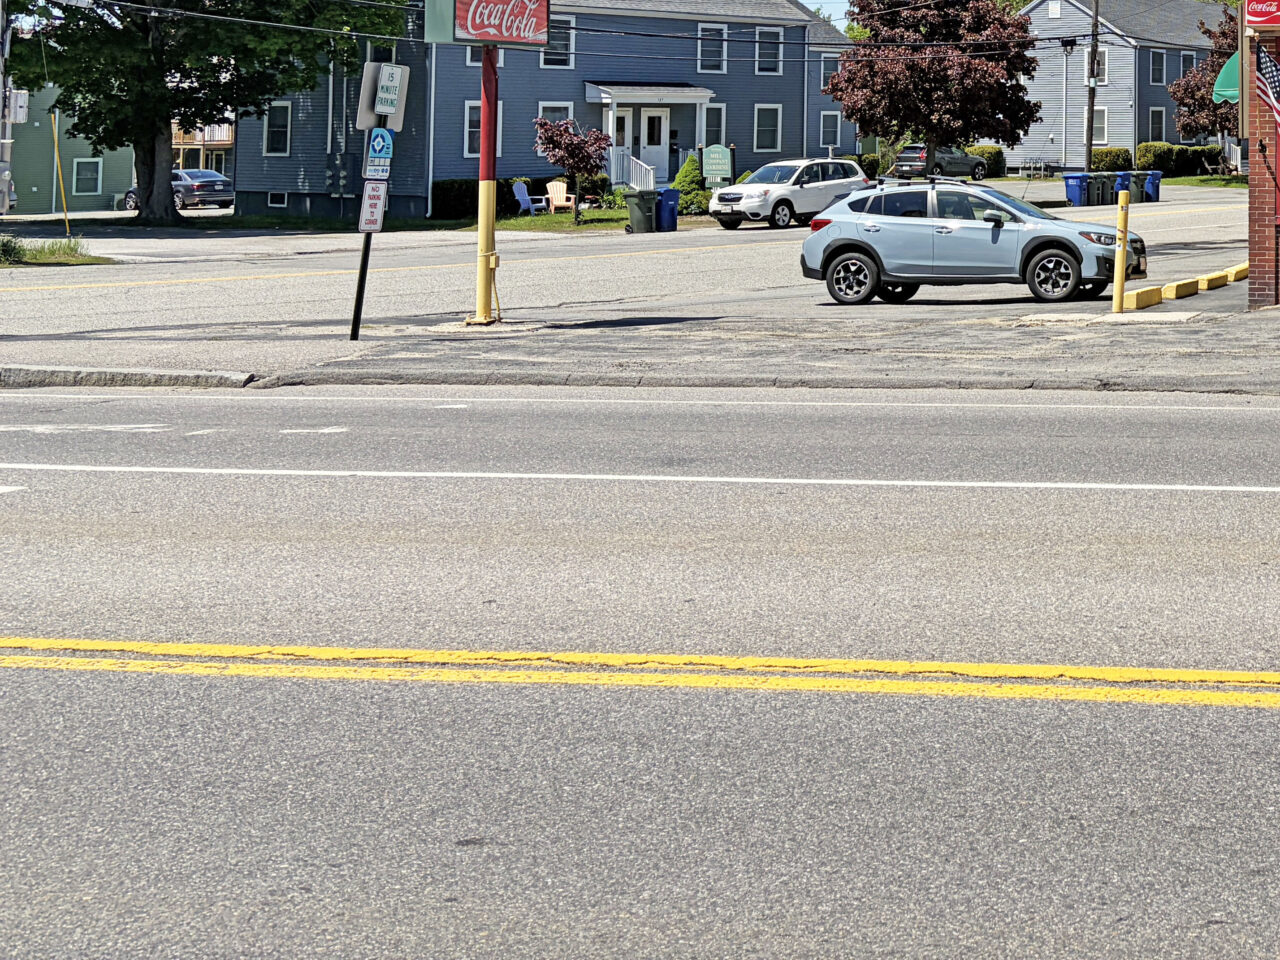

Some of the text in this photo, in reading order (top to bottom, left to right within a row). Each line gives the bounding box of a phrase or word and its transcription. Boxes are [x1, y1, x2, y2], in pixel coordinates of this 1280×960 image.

[388, 72, 395, 82] 15
[380, 84, 398, 96] MINUTE
[377, 96, 397, 107] PARKING
